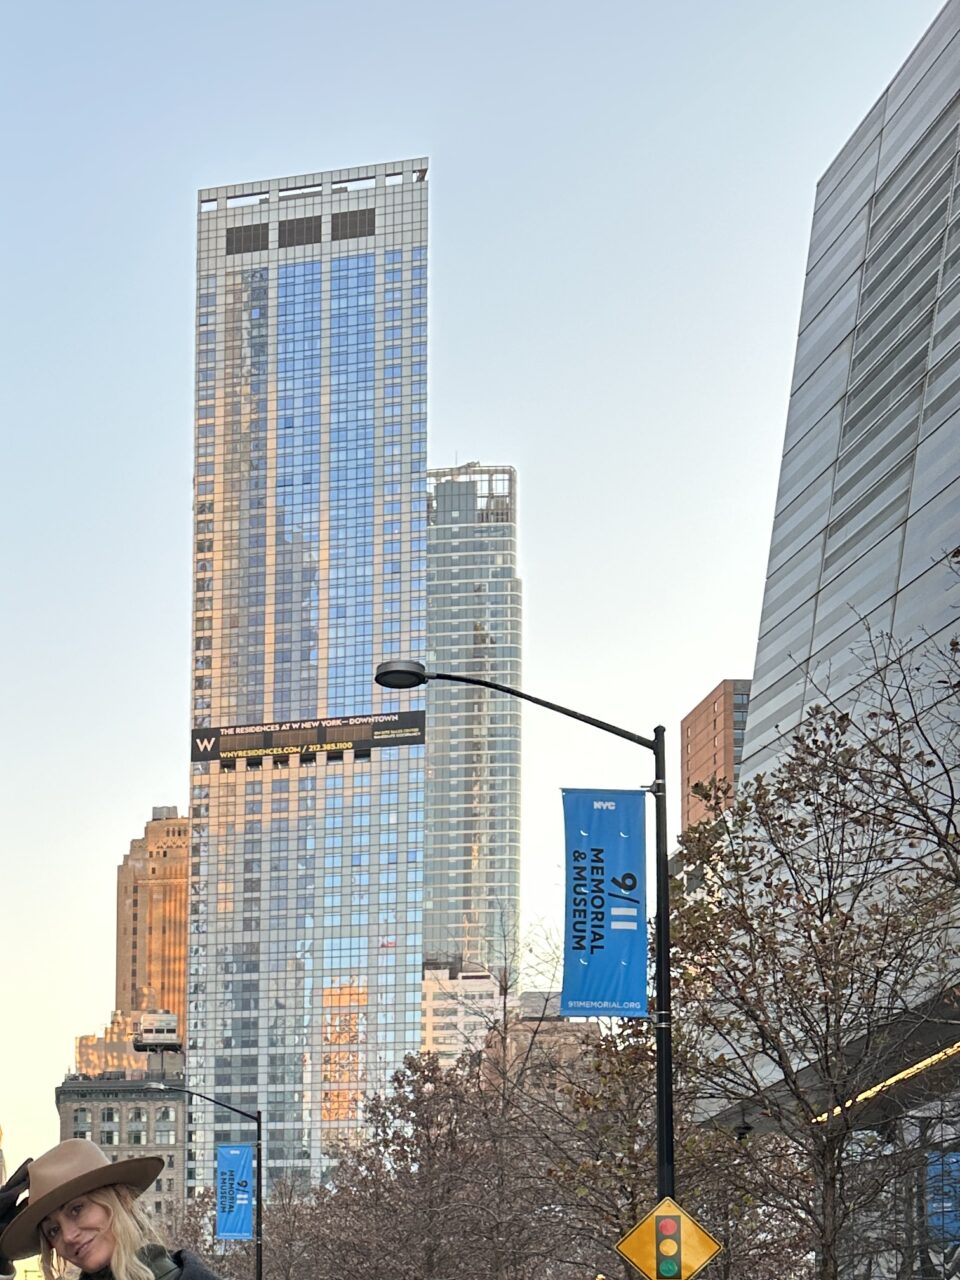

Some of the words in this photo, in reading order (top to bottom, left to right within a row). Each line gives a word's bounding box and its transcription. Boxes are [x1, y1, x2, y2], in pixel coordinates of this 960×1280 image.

[235, 724, 279, 734] RESIDENCES
[281, 723, 290, 731] AT
[301, 721, 320, 729] NEW
[349, 715, 399, 725] DOWNTOWN
[195, 737, 216, 752] W
[220, 745, 300, 758] WNYRESIDENCES.COM
[593, 801, 616, 810] NYC
[572, 850, 587, 862] &
[572, 866, 587, 951] MUSEUM
[590, 847, 604, 954] MEMORIAL
[609, 872, 640, 930] 9/11
[568, 1000, 641, 1009] 911MEMORIAL.ORG
[236, 1180, 250, 1204] 9/11
